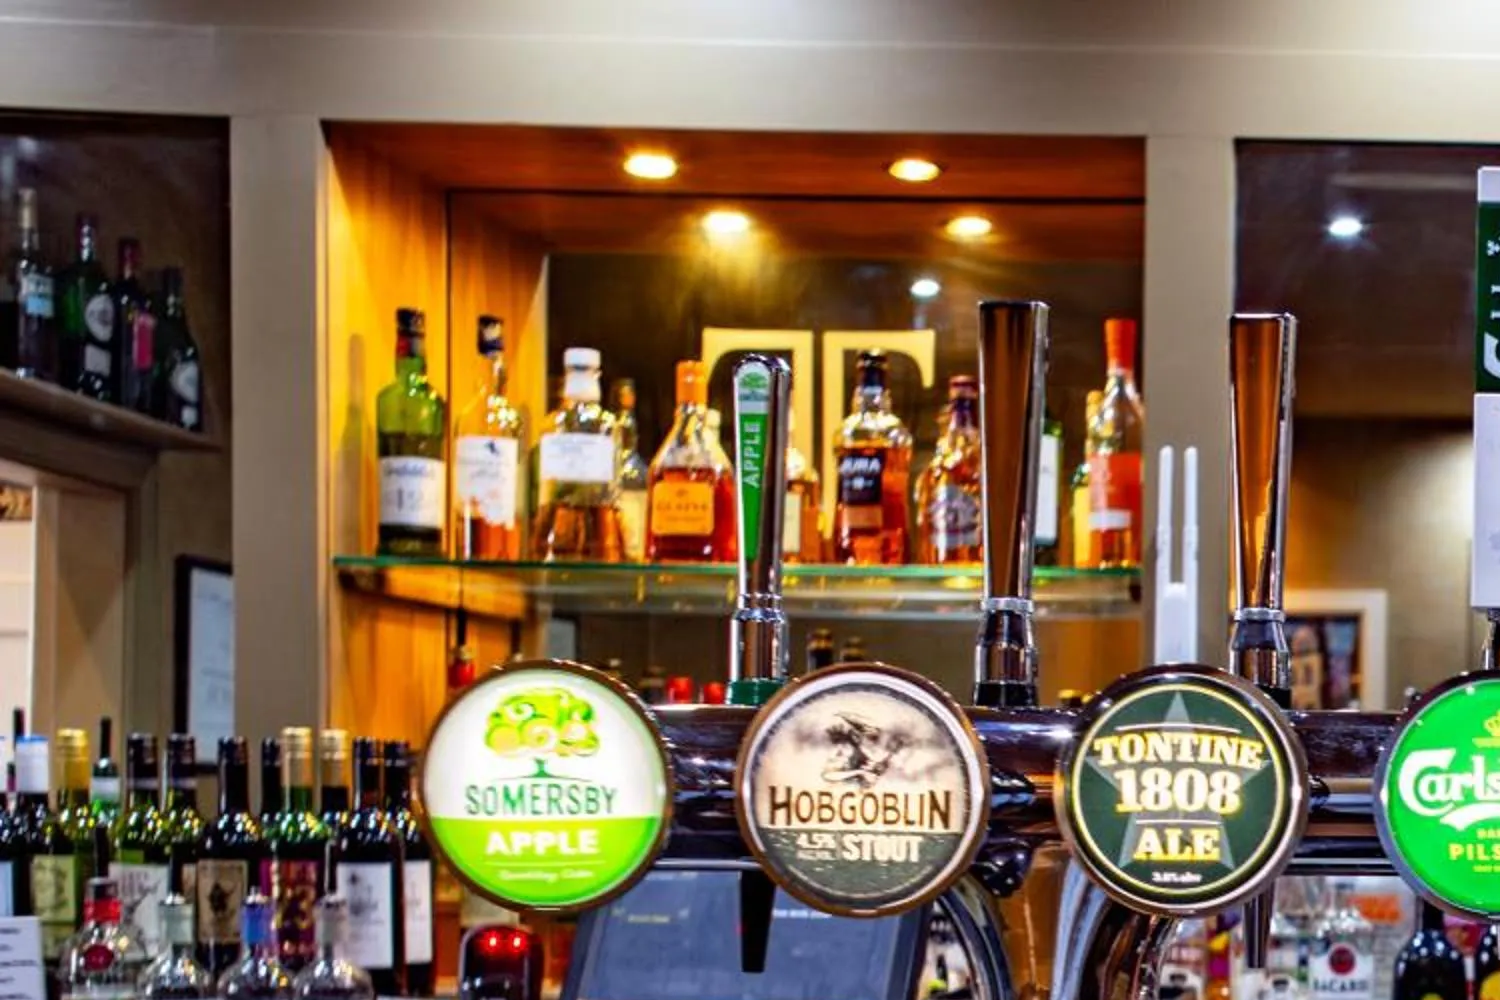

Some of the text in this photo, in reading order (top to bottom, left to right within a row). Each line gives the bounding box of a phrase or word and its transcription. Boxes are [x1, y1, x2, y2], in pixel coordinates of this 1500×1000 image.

[743, 421, 761, 488] APPLE
[1093, 732, 1264, 769] TONTINE
[463, 783, 618, 817] SOMERSBY
[769, 786, 953, 830] HOBGOBLIN
[1113, 767, 1243, 814] 1808
[485, 829, 600, 858] APPLE
[841, 832, 924, 863] STOUT
[1132, 828, 1221, 862] ALE
